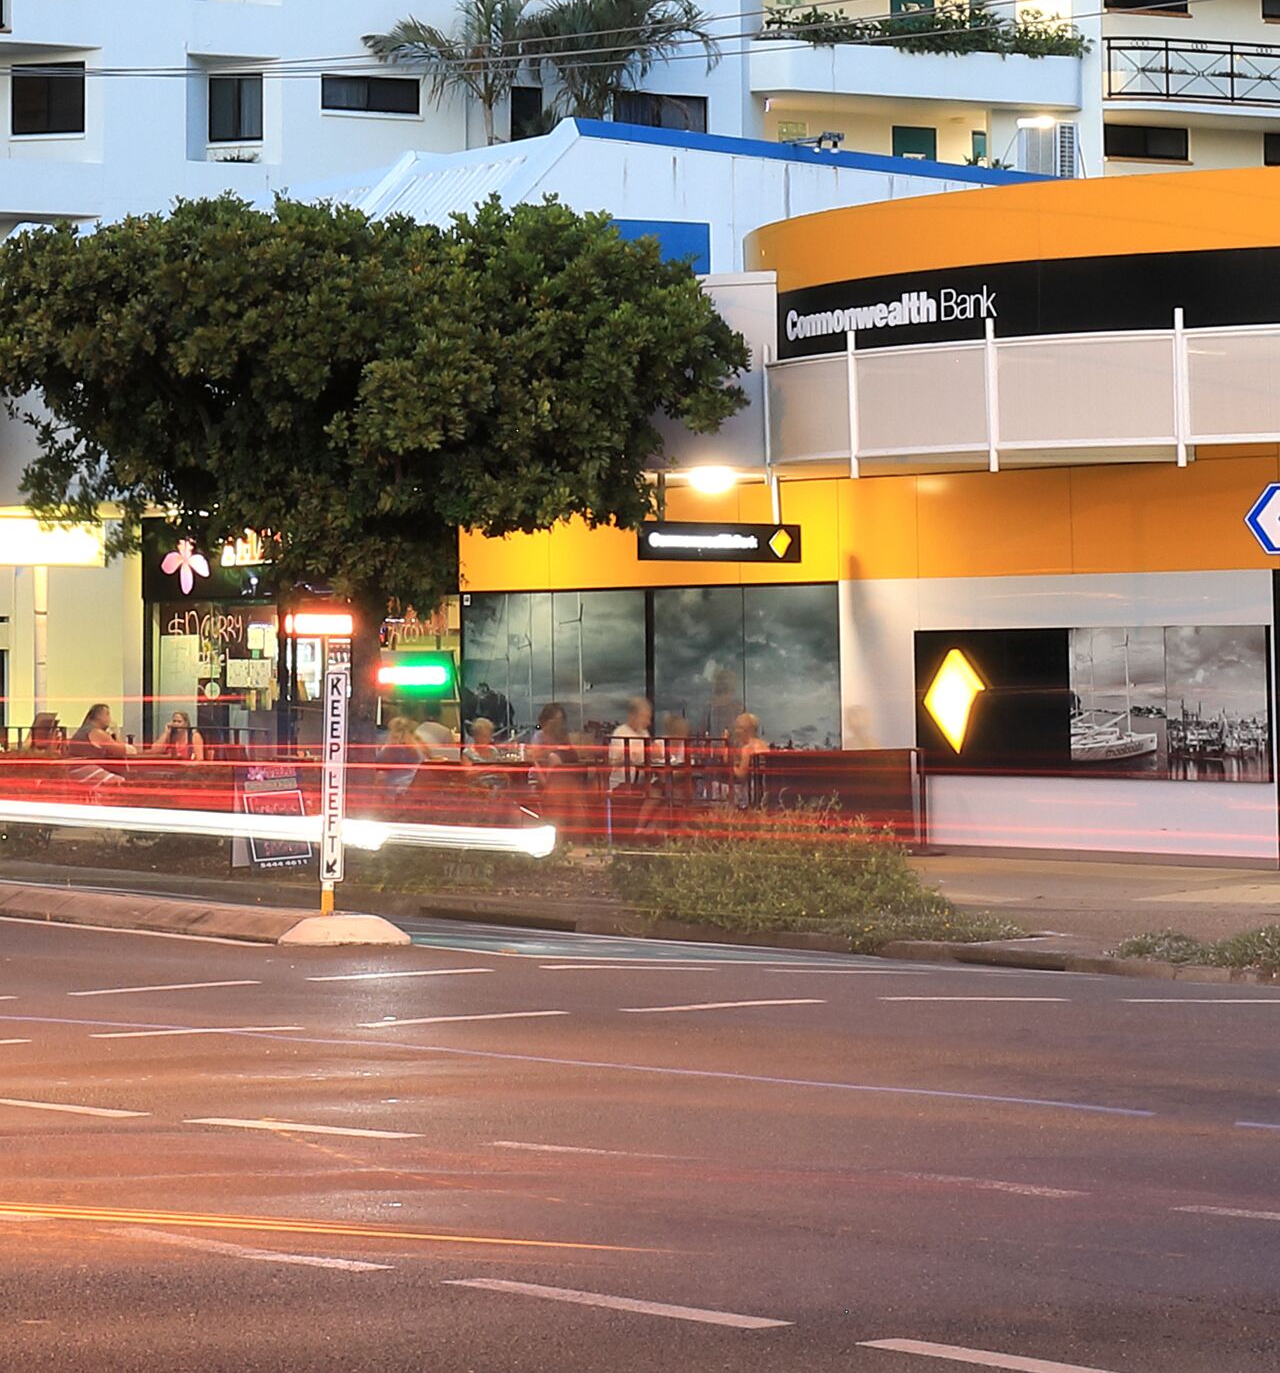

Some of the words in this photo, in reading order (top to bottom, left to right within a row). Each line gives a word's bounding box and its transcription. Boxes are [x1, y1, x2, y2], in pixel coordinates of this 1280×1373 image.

[786, 290, 937, 342] Commonwealth
[940, 283, 999, 321] Bank
[328, 676, 342, 761] KEEP
[327, 770, 339, 853] LEFT
